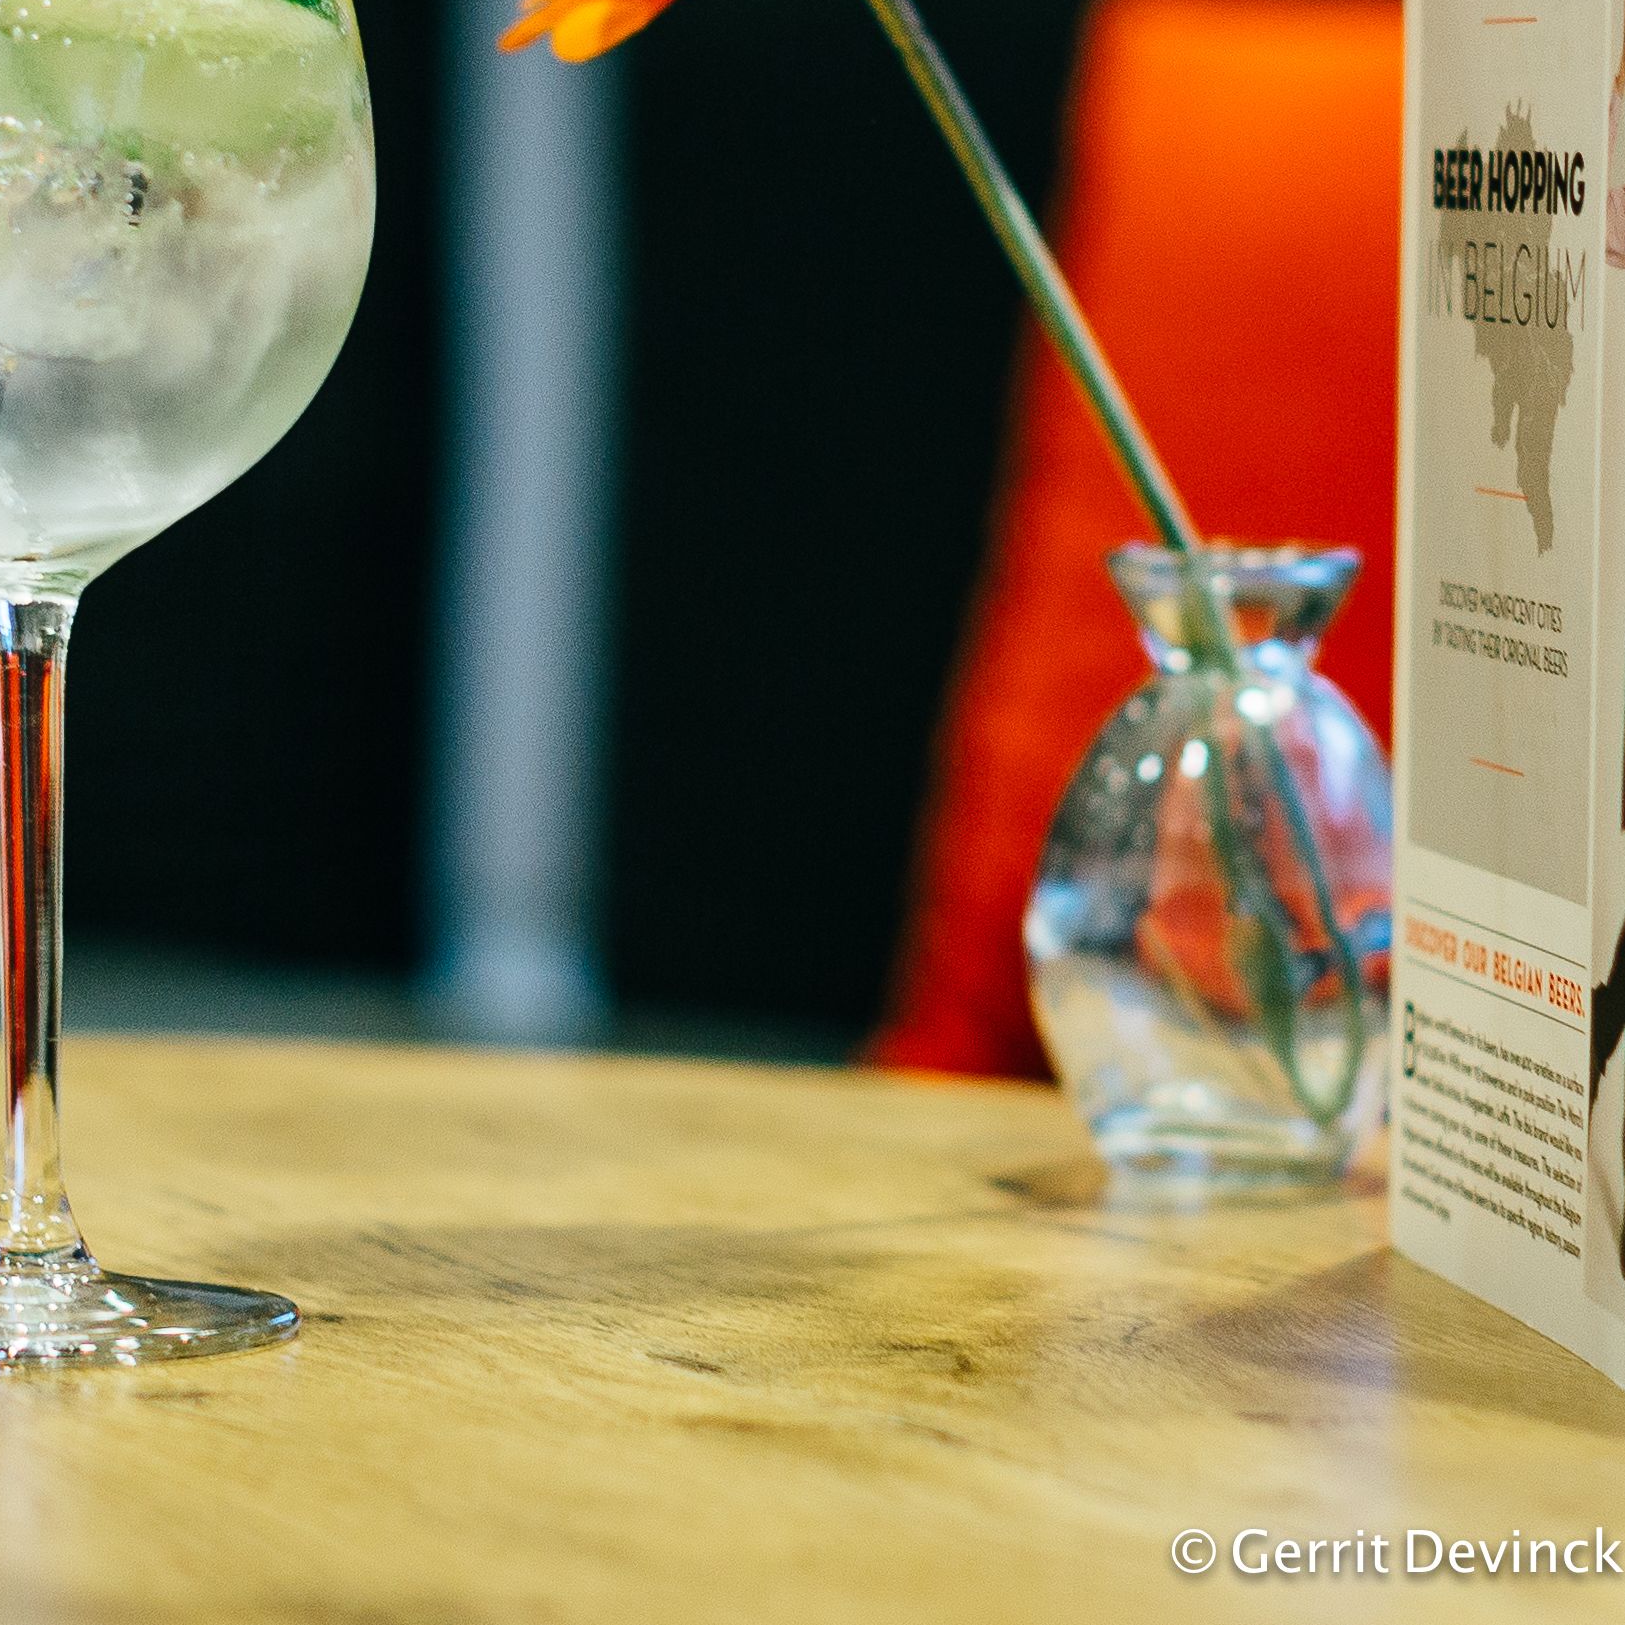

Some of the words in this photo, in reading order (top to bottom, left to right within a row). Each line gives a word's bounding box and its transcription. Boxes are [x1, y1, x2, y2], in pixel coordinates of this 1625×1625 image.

[1434, 148, 1483, 212] BEER
[1488, 150, 1585, 216] HOPPING
[1464, 240, 1585, 331] BELGIUM
[1463, 940, 1487, 976] OUR
[1493, 950, 1543, 998] BELGIAN
